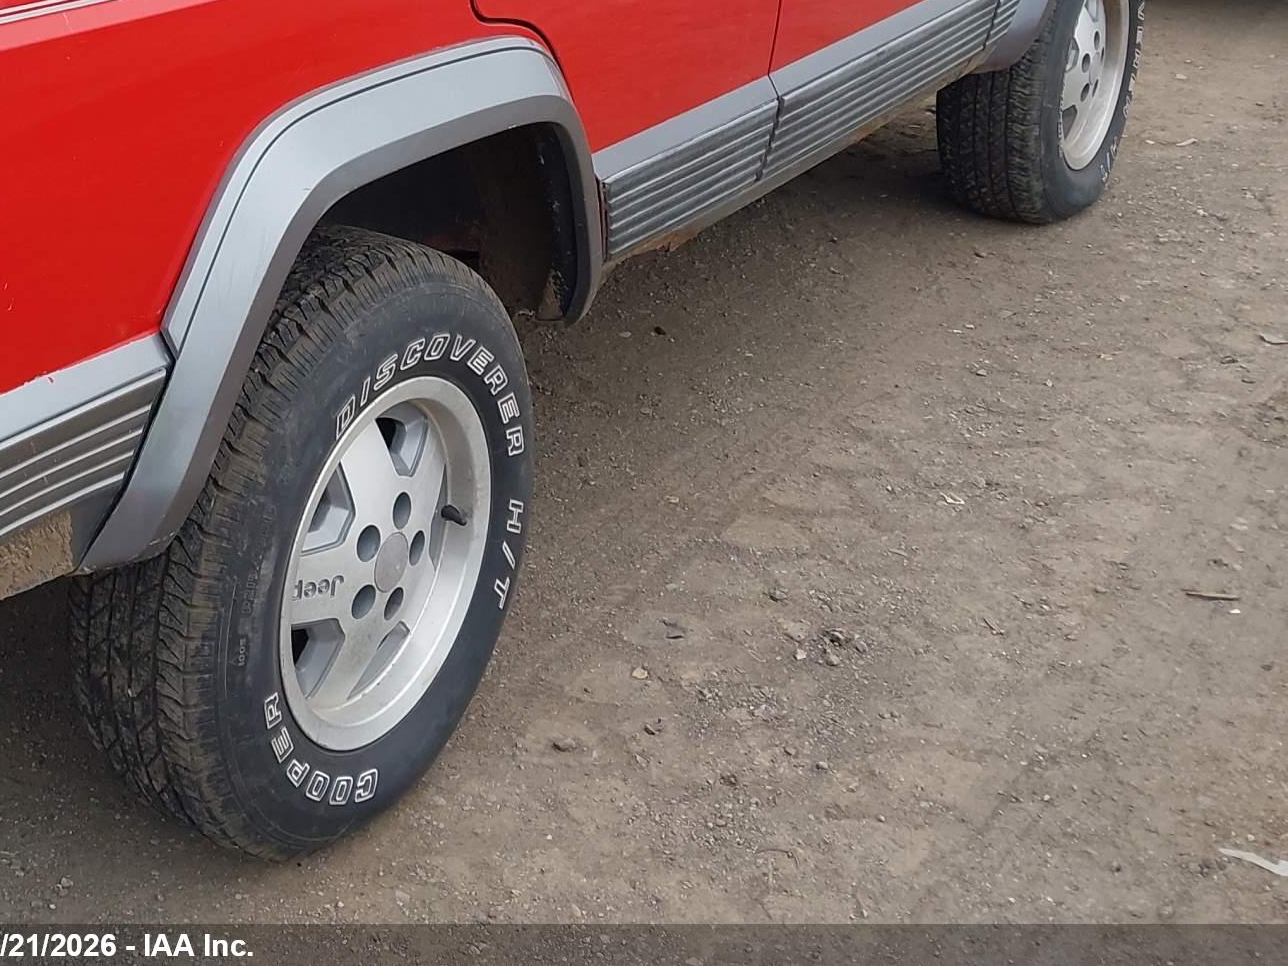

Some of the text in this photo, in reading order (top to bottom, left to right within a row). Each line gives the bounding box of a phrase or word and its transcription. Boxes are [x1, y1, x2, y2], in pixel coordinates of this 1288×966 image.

[333, 333, 526, 611] DISCOVERER H/T
[292, 575, 345, 601] Jeep
[264, 690, 379, 807] COOPER
